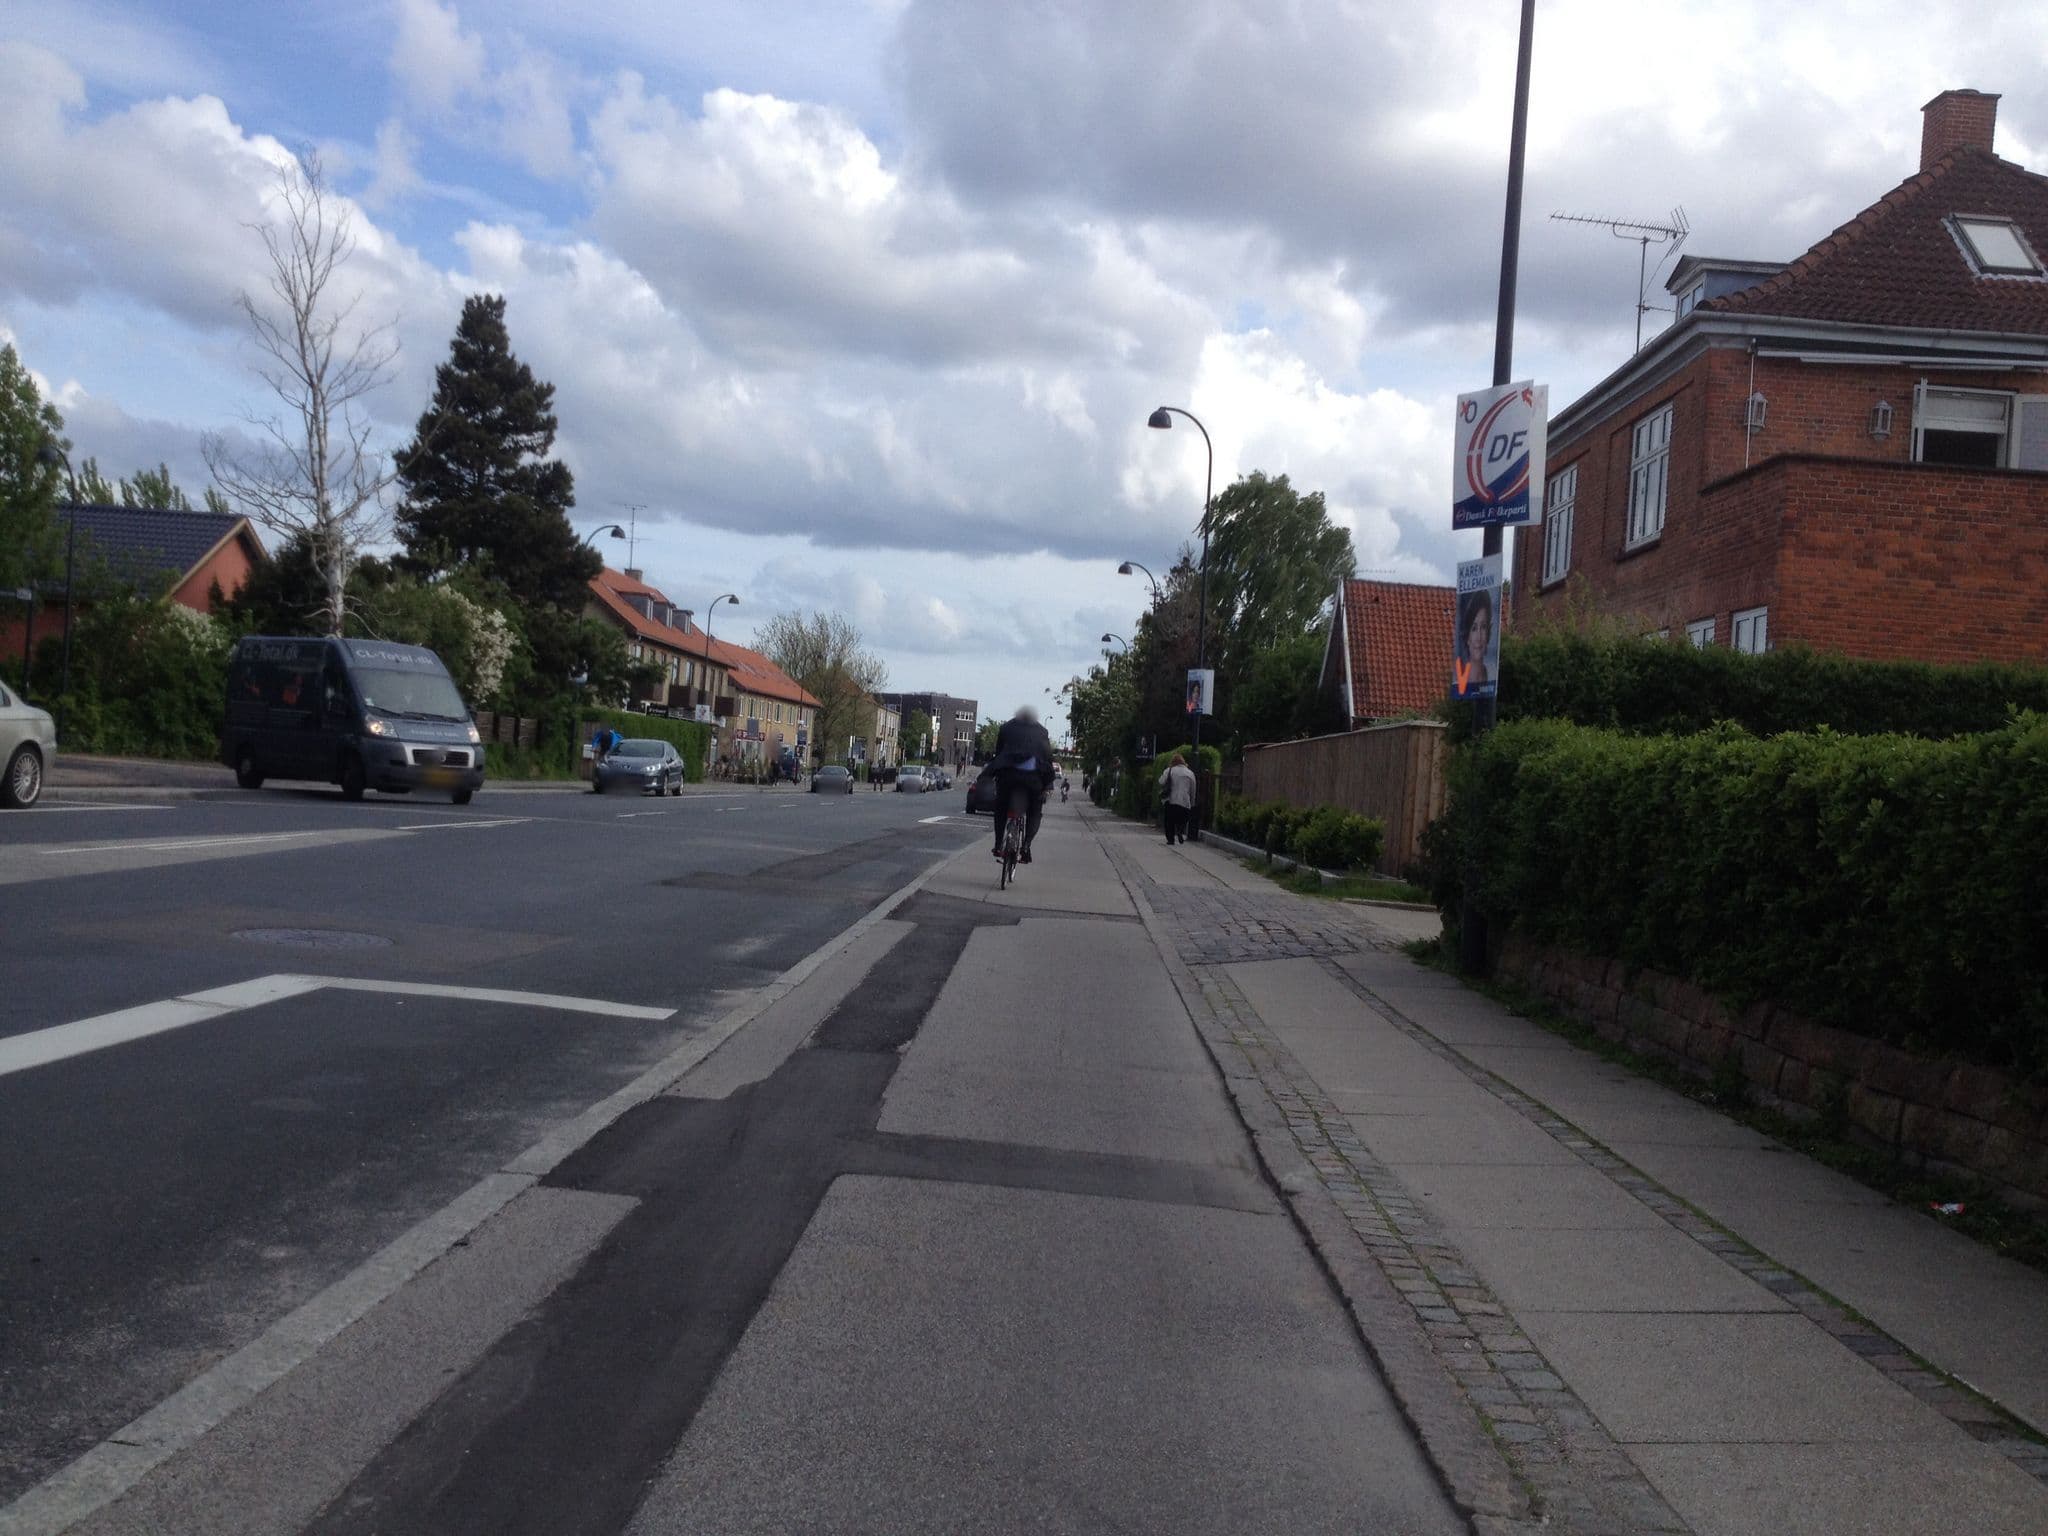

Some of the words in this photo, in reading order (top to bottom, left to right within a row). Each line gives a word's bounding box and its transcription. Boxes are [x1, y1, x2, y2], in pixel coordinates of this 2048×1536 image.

[1488, 430, 1528, 463] DF
[1465, 509, 1486, 522] Dansk
[1459, 564, 1484, 578] KAREN
[1459, 575, 1495, 592] ELLEMANN
[1456, 656, 1472, 695] V
